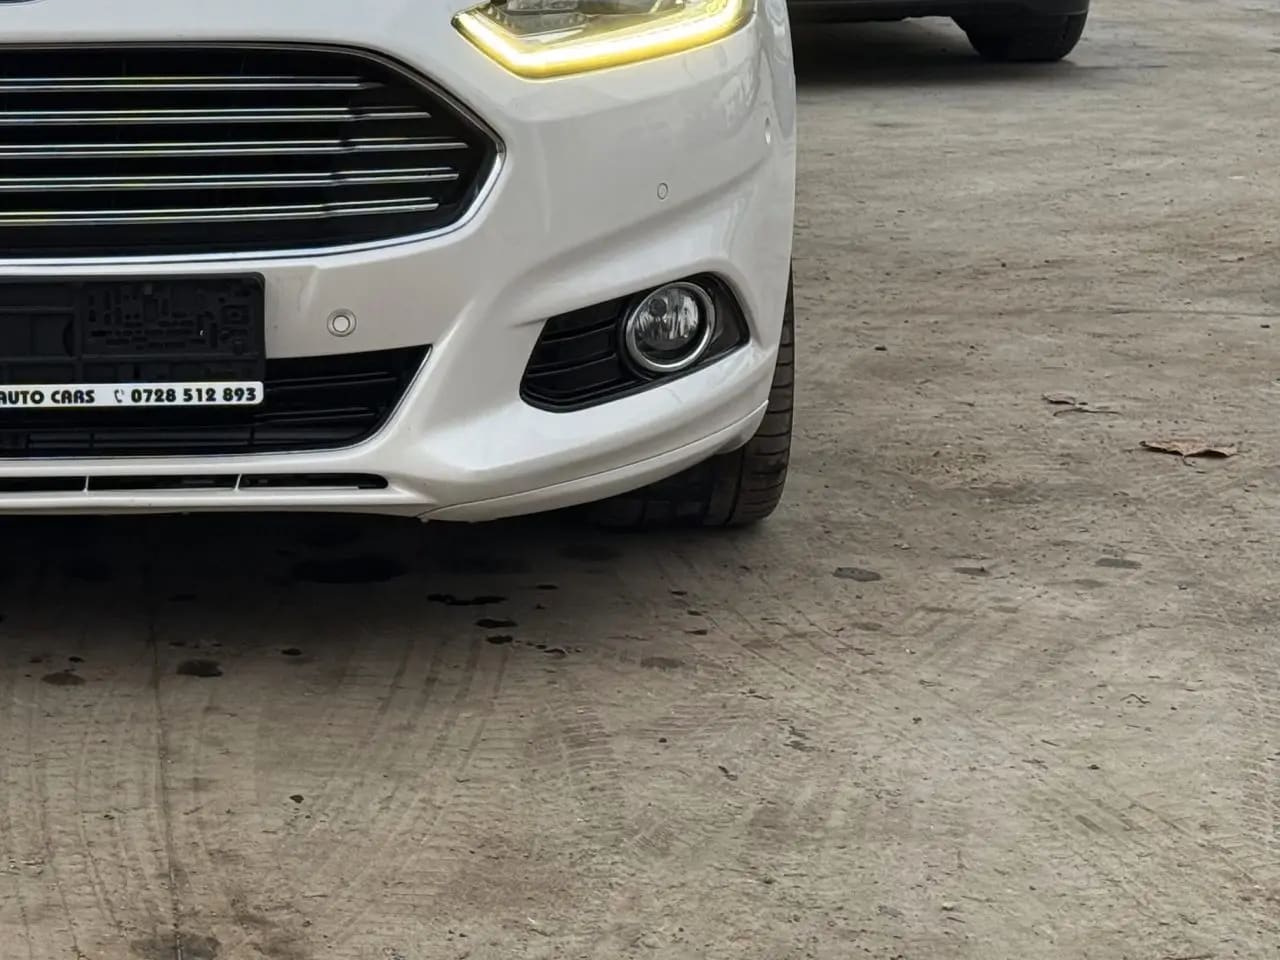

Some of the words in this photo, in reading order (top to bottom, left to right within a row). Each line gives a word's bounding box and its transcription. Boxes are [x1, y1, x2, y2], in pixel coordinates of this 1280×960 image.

[51, 390, 96, 404] CARS
[131, 388, 177, 403] 0728
[183, 388, 216, 402] 512
[222, 387, 257, 401] 893
